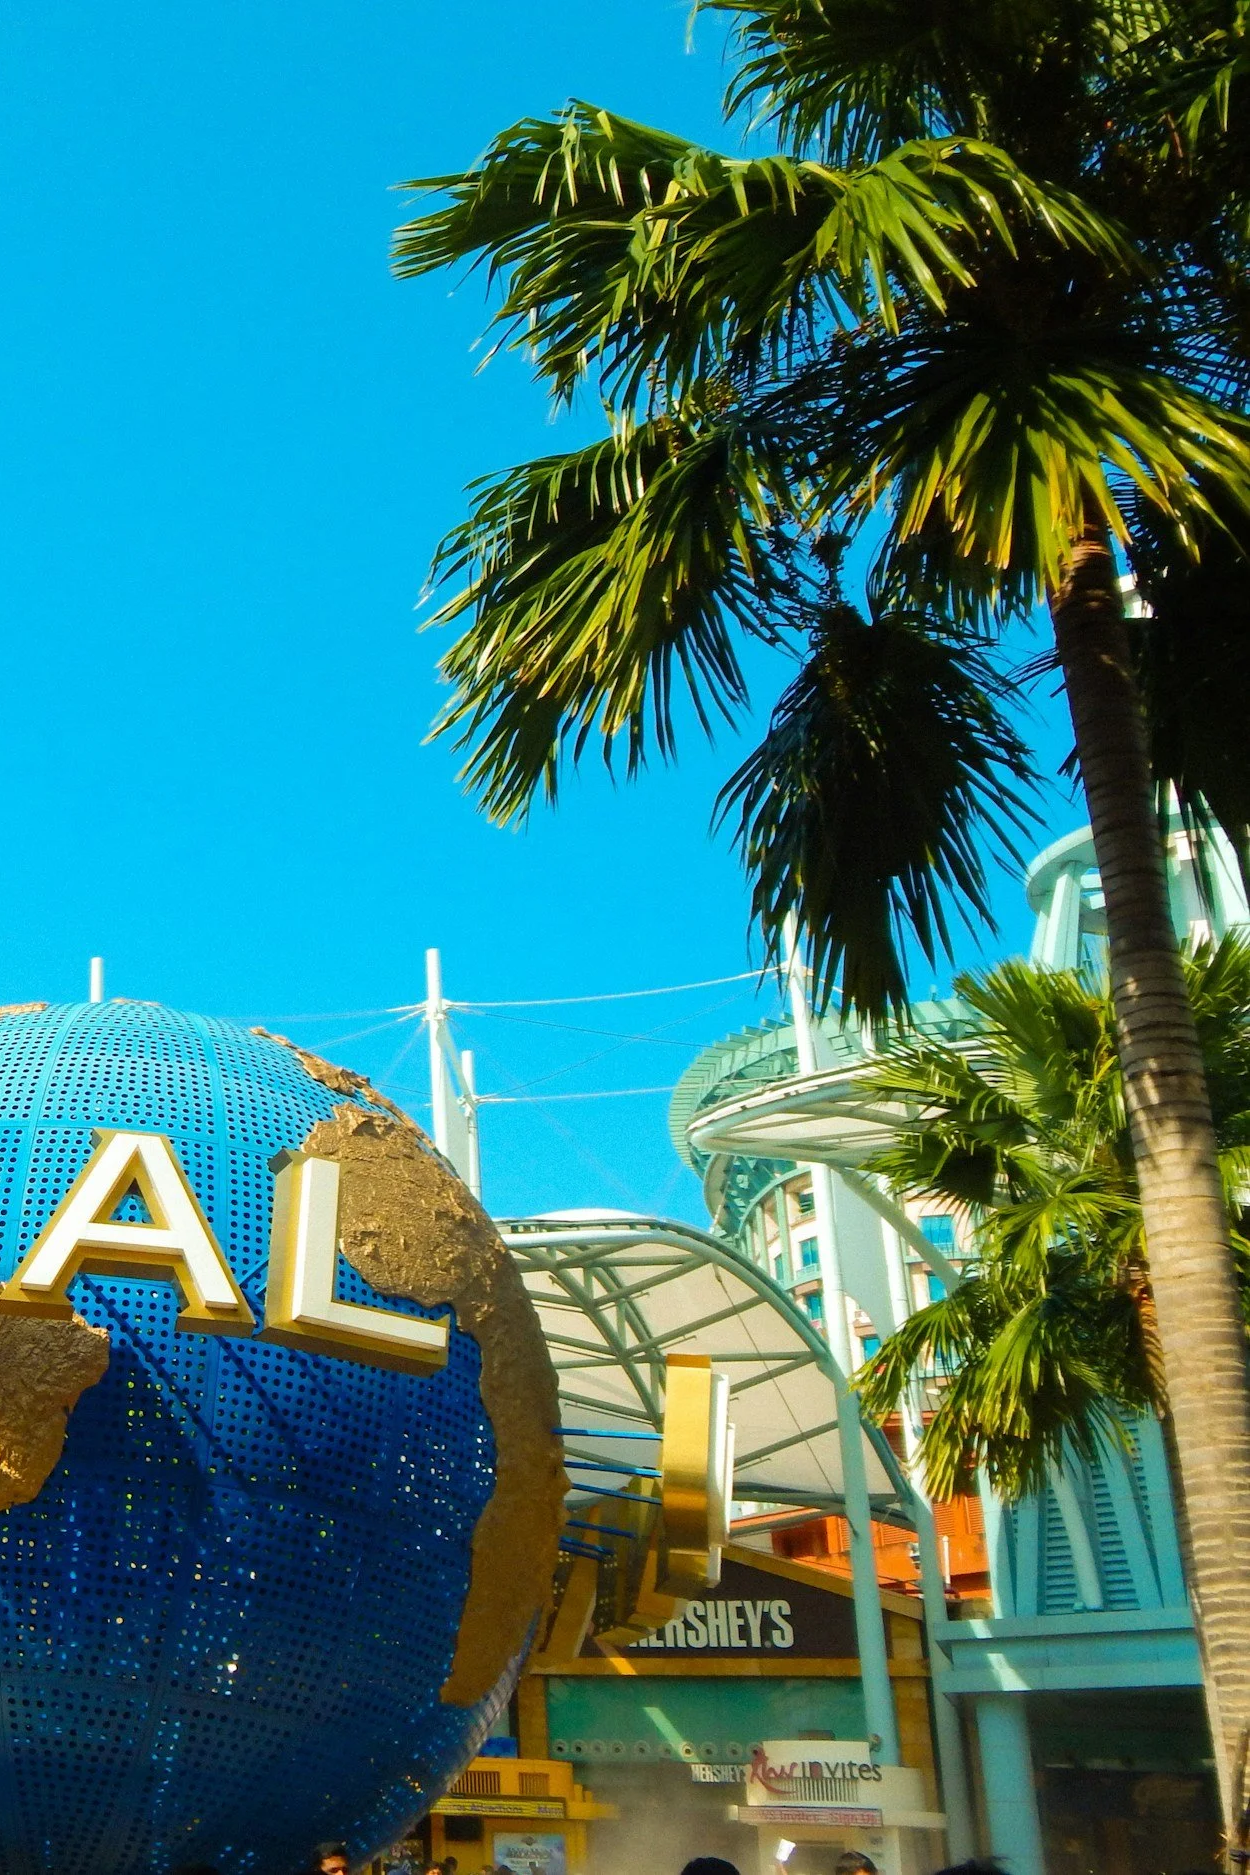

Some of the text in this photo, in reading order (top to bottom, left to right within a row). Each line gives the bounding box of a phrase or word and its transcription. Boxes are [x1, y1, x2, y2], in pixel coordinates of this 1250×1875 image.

[628, 1599, 795, 1649] RSHEY'S
[691, 1764, 746, 1784] HERSHEY'
[801, 1760, 883, 1783] invites
